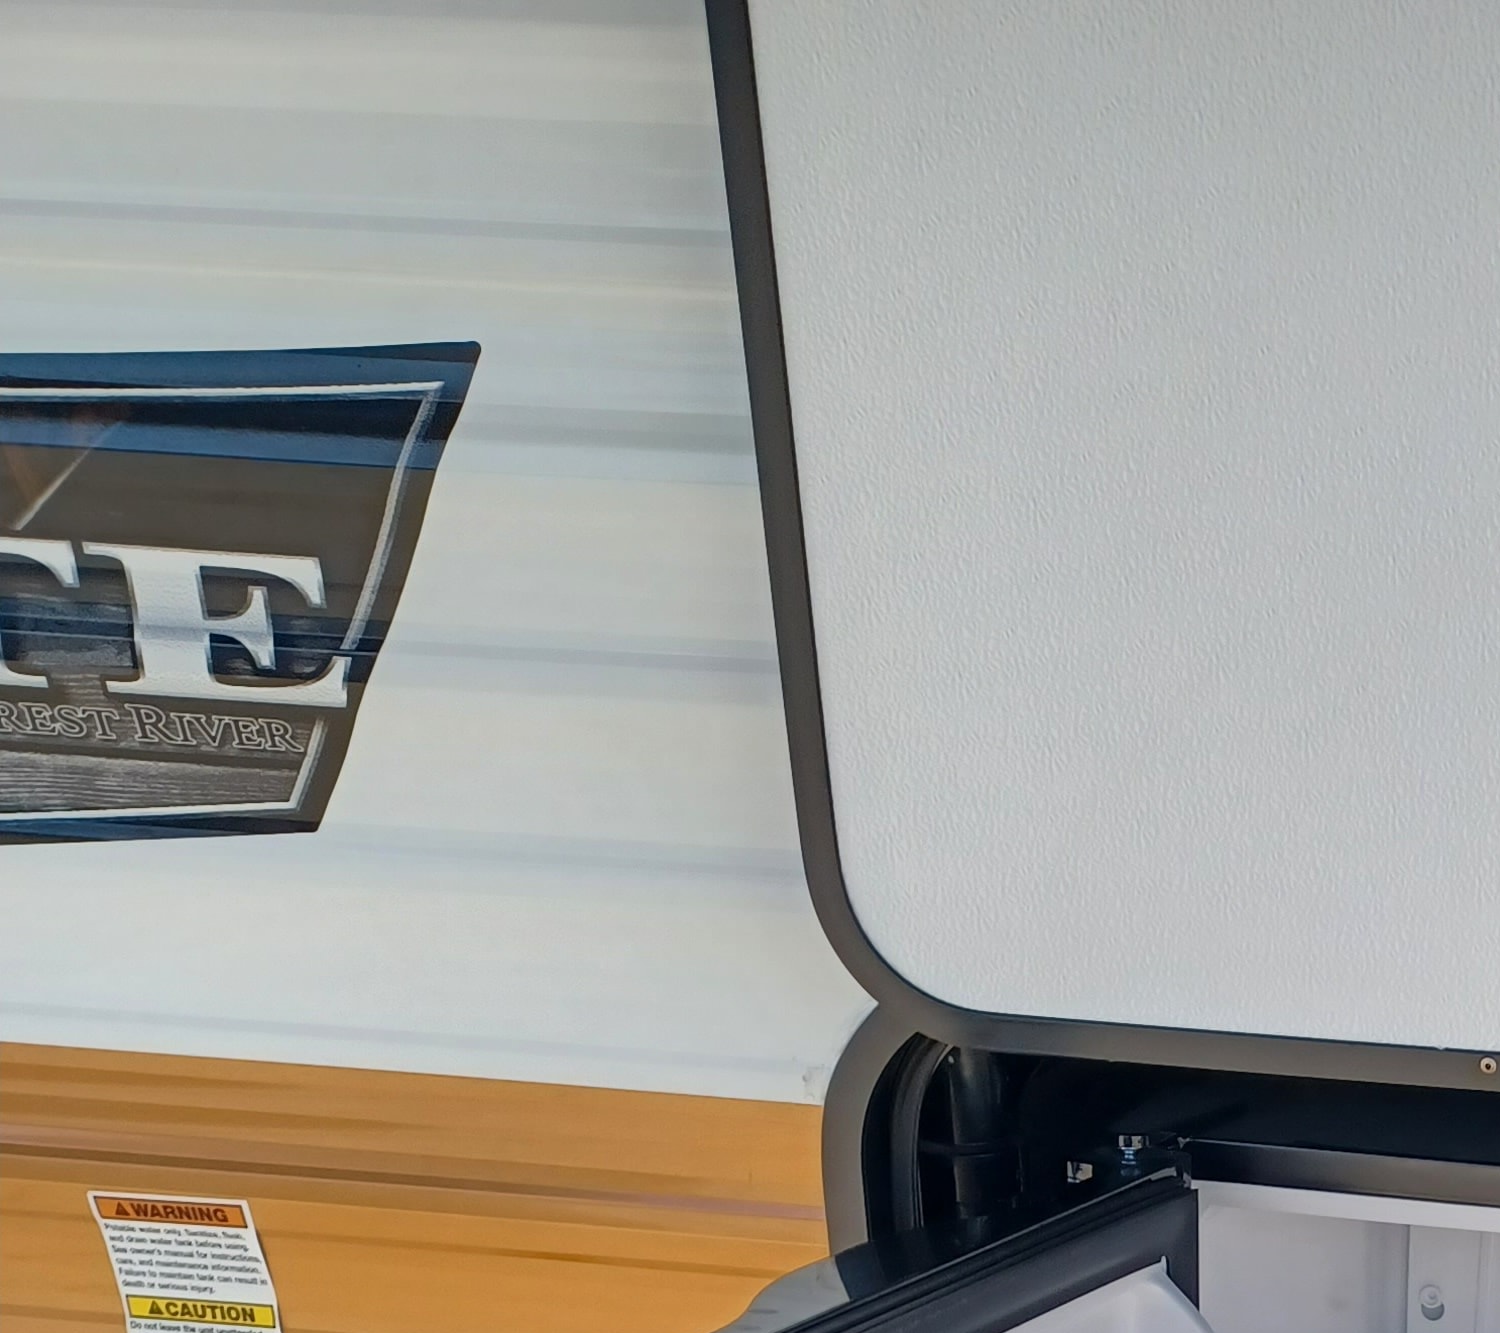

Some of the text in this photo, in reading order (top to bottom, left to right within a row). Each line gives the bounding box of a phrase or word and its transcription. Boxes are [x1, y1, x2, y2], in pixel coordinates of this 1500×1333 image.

[125, 704, 304, 752] RIVER
[129, 1202, 228, 1222] WARNING
[165, 1302, 255, 1322] CAUTION
